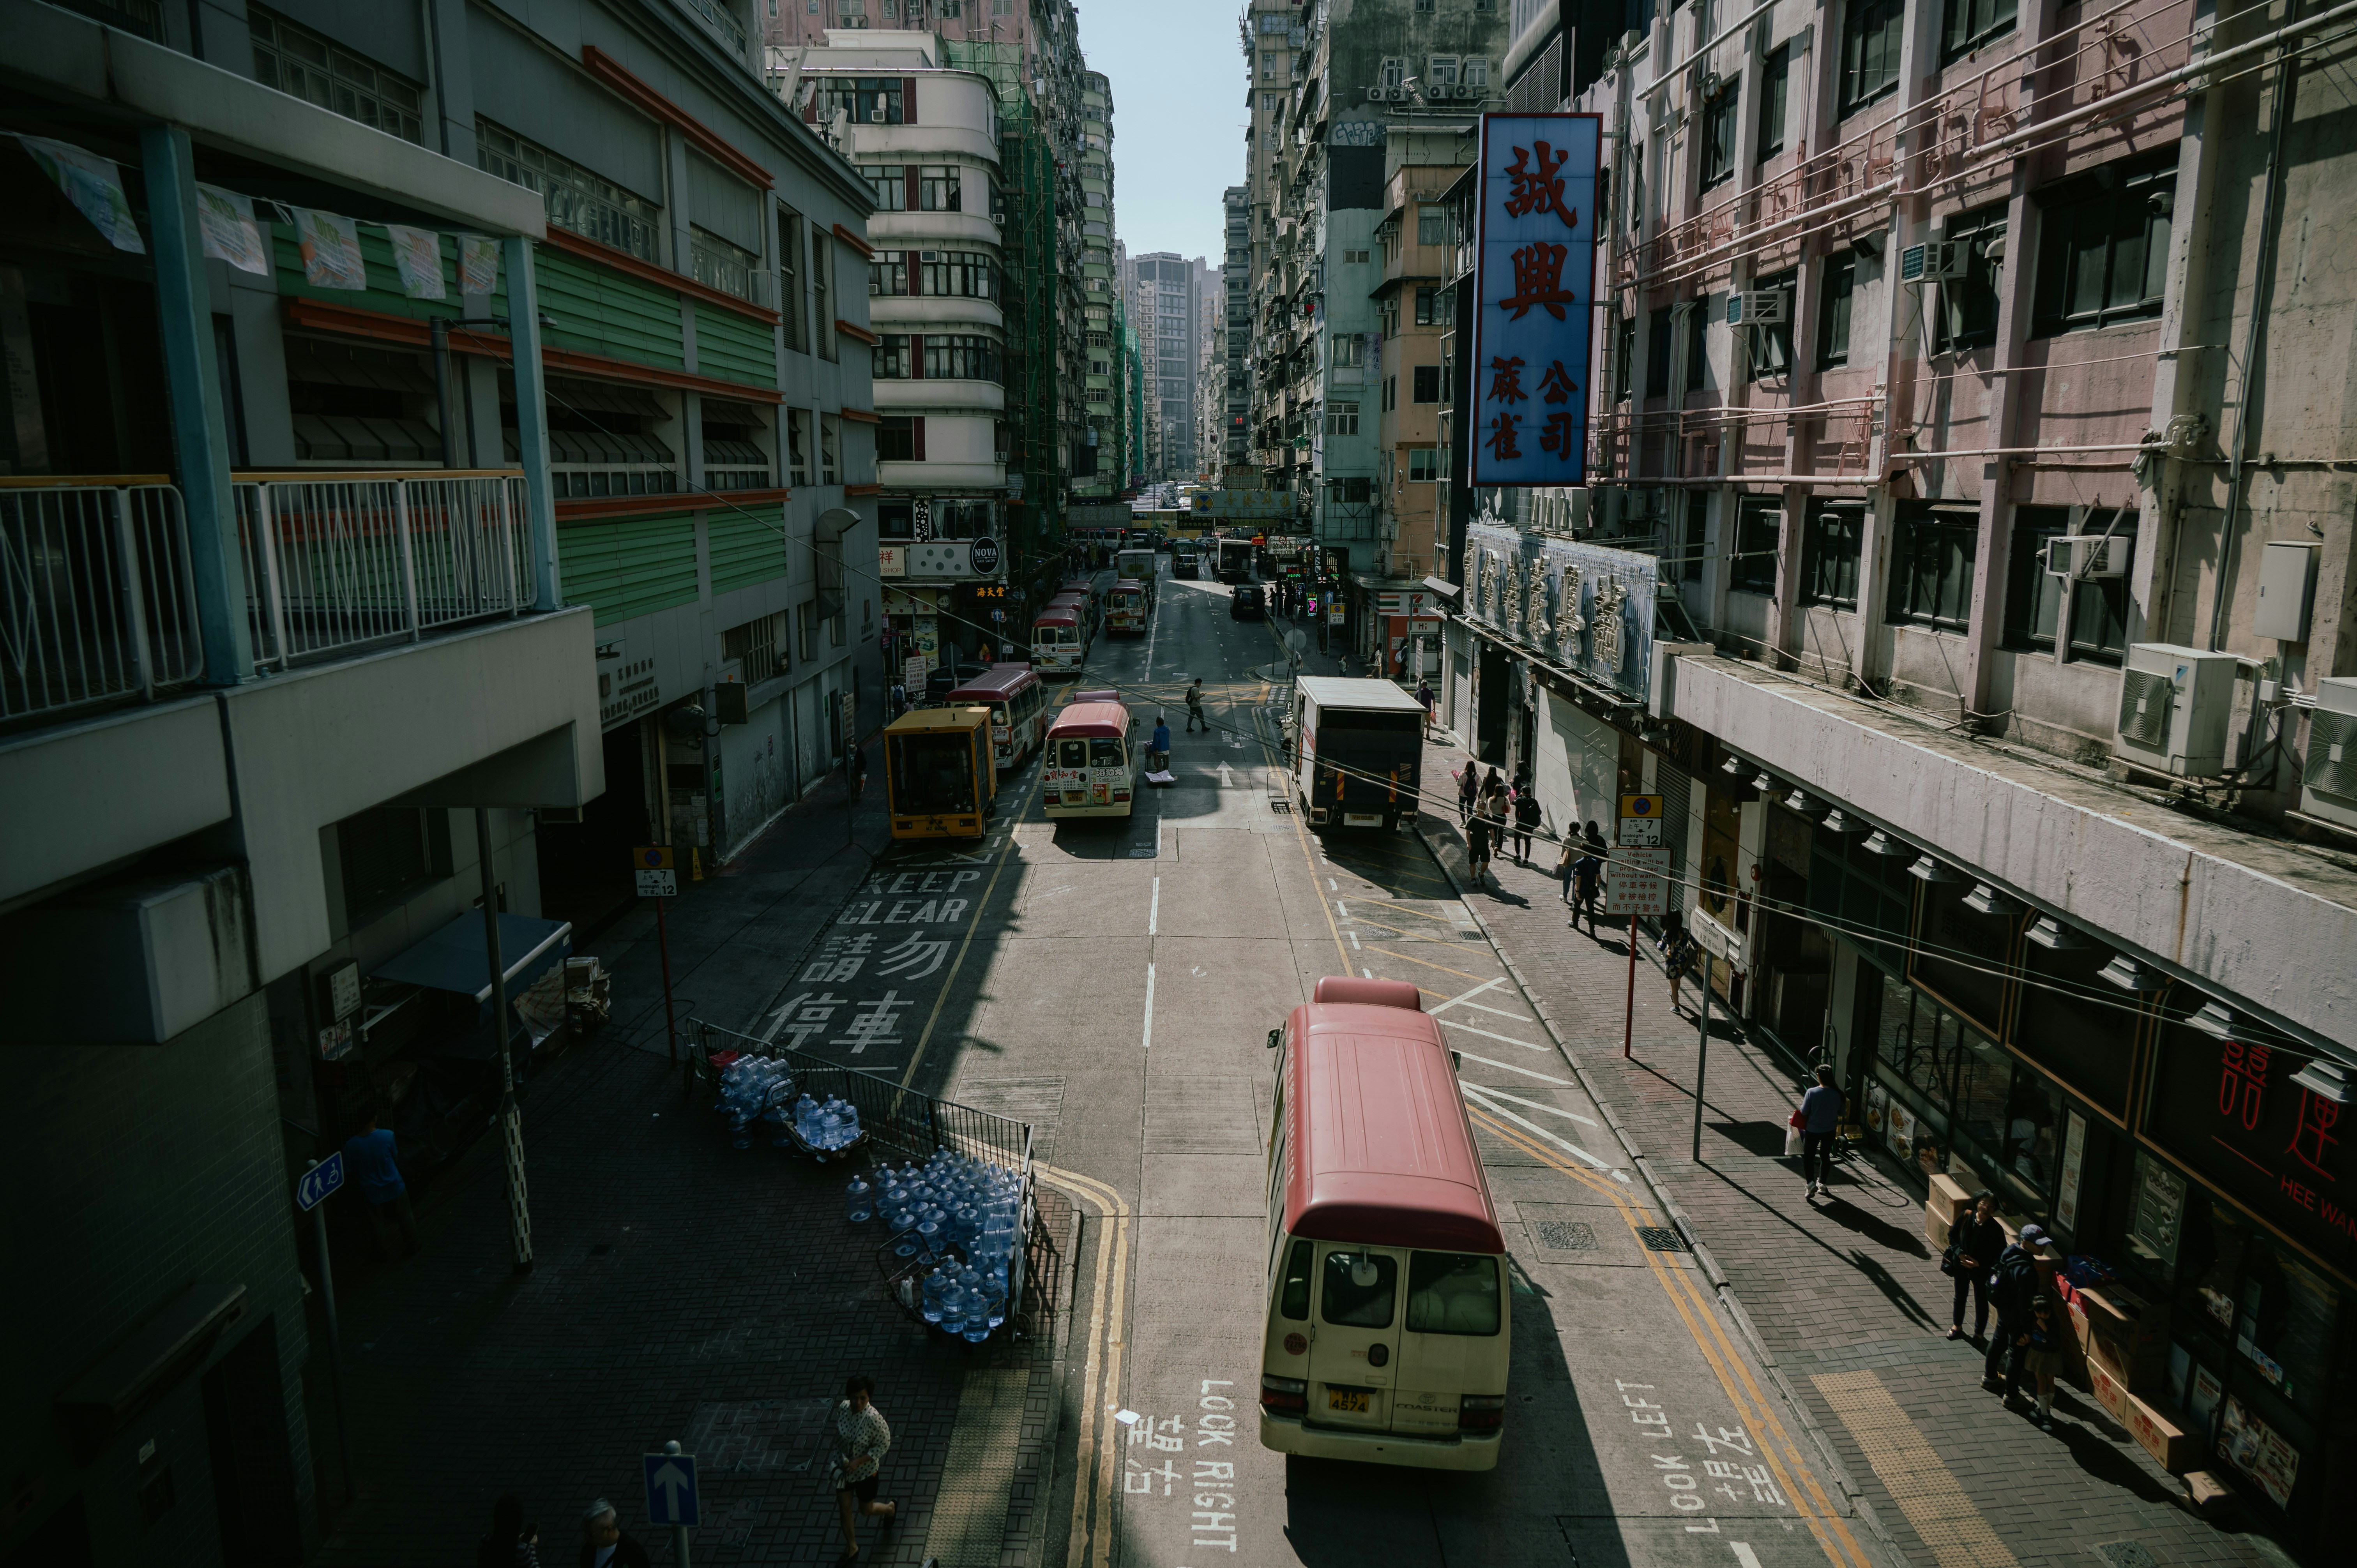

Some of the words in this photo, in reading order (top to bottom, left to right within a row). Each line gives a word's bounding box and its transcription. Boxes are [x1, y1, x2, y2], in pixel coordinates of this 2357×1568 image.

[1499, 141, 1577, 321] 誠興
[1537, 360, 1578, 461] 公司
[879, 550, 894, 565] 祥
[975, 548, 997, 557] NOVA
[977, 586, 1005, 598] 海天堂
[1647, 820, 1653, 829] 7
[1647, 835, 1659, 845] 12
[659, 871, 667, 879] 7
[859, 870, 981, 894] KEEP
[662, 886, 674, 894] 12
[1618, 881, 1657, 890] 停車等候
[1618, 892, 1656, 901] 會被檢控
[836, 899, 968, 924] CLEAR
[1613, 904, 1660, 913] 而不予警告
[1709, 928, 1719, 940] Street
[799, 931, 952, 983] 請勿
[754, 990, 915, 1054] 停車
[2281, 1174, 2316, 1212] HEE
[2321, 1198, 2357, 1241] WAN
[1342, 1392, 1358, 1402] WK
[1197, 1379, 1236, 1446] LOOK
[1332, 1400, 1366, 1413] 4574
[1396, 1403, 1458, 1413] COASTER
[1615, 1379, 1673, 1437] LEFT
[1692, 1422, 1786, 1506] 望左
[1650, 1454, 1720, 1533] LOOK
[1191, 1460, 1237, 1552] RIGHT
